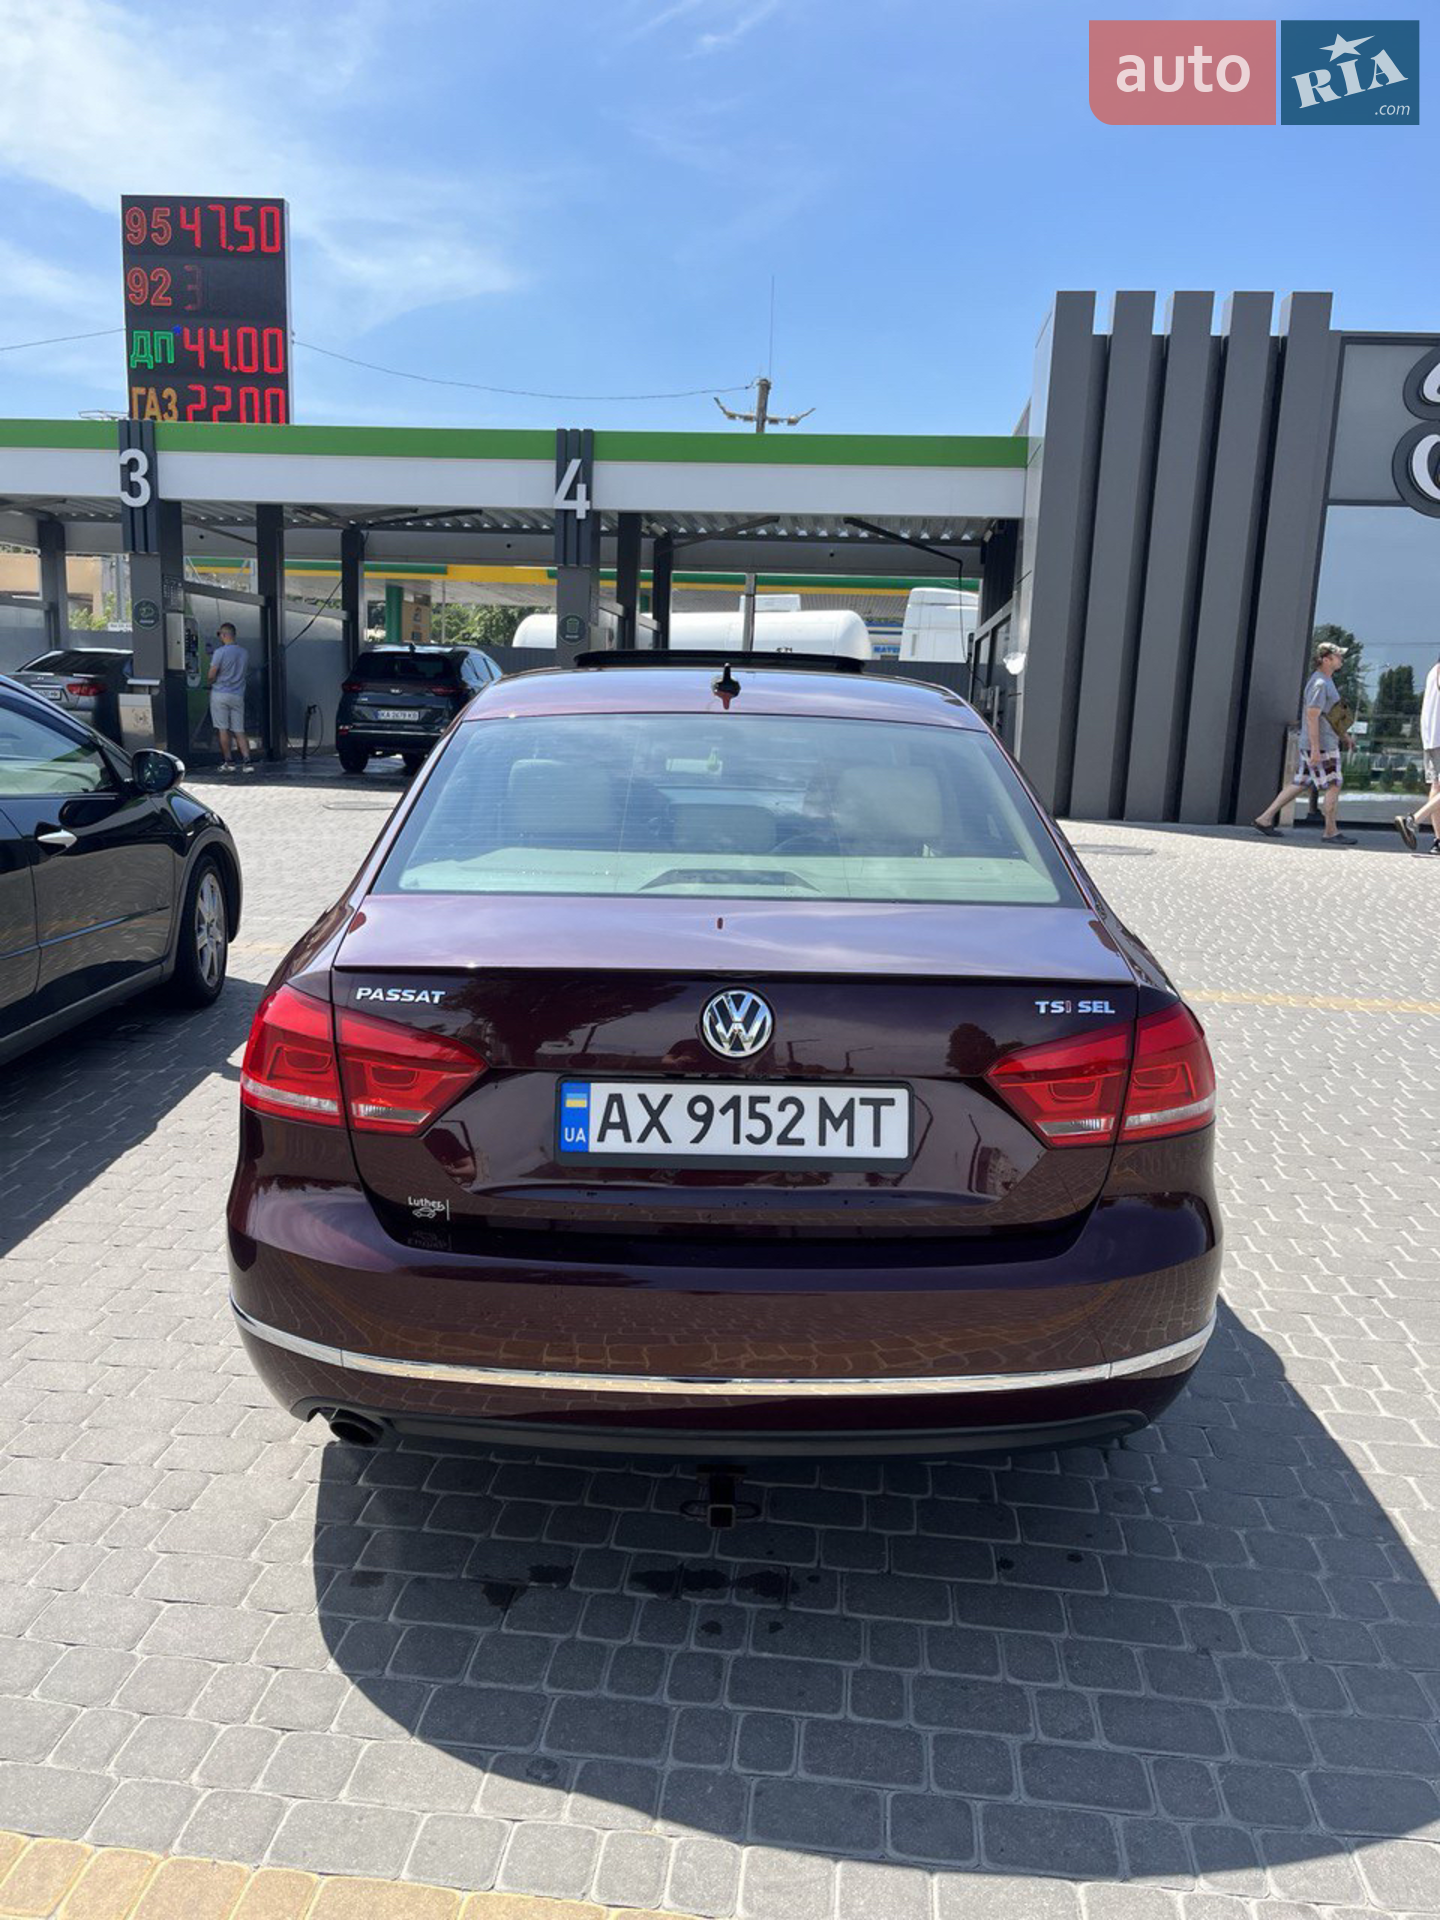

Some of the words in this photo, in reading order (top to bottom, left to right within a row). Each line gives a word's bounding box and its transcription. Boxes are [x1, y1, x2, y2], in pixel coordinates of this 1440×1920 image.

[125, 206, 172, 246] 95
[179, 203, 281, 253] 47.50
[127, 266, 172, 306] 92
[182, 325, 284, 374] 44.00
[131, 386, 178, 422] ГАЗ
[119, 448, 151, 507] 3
[553, 458, 591, 520] 4
[356, 987, 446, 1004] PASSAT
[1077, 1001, 1116, 1014] SEL
[564, 1127, 587, 1143] UA
[596, 1092, 674, 1144] AX
[685, 1094, 806, 1147] 9152
[818, 1096, 896, 1148] MT
